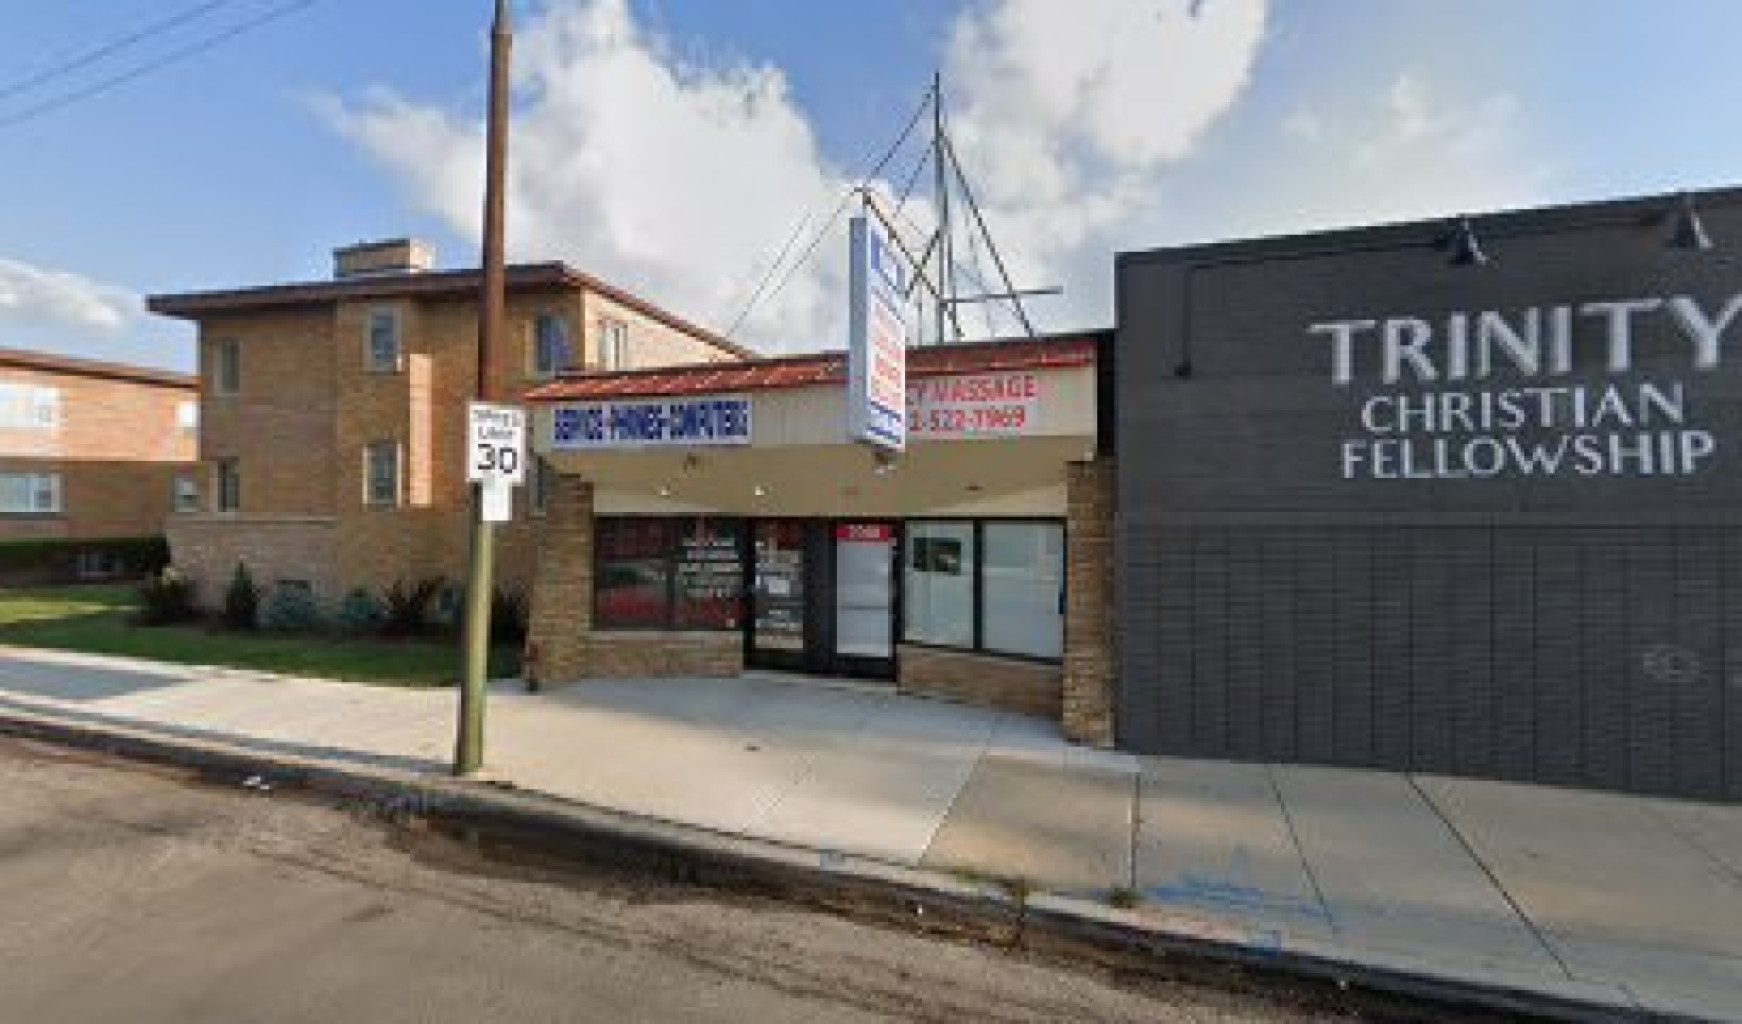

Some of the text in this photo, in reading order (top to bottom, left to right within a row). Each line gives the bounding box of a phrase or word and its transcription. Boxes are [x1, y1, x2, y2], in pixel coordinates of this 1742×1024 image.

[1306, 294, 1742, 386] TRINITY
[935, 375, 1037, 402] MASSAGE
[1361, 381, 1684, 433] CHRISTIAN
[477, 443, 518, 474] 30
[1341, 429, 1714, 479] FELLOWSHIP
